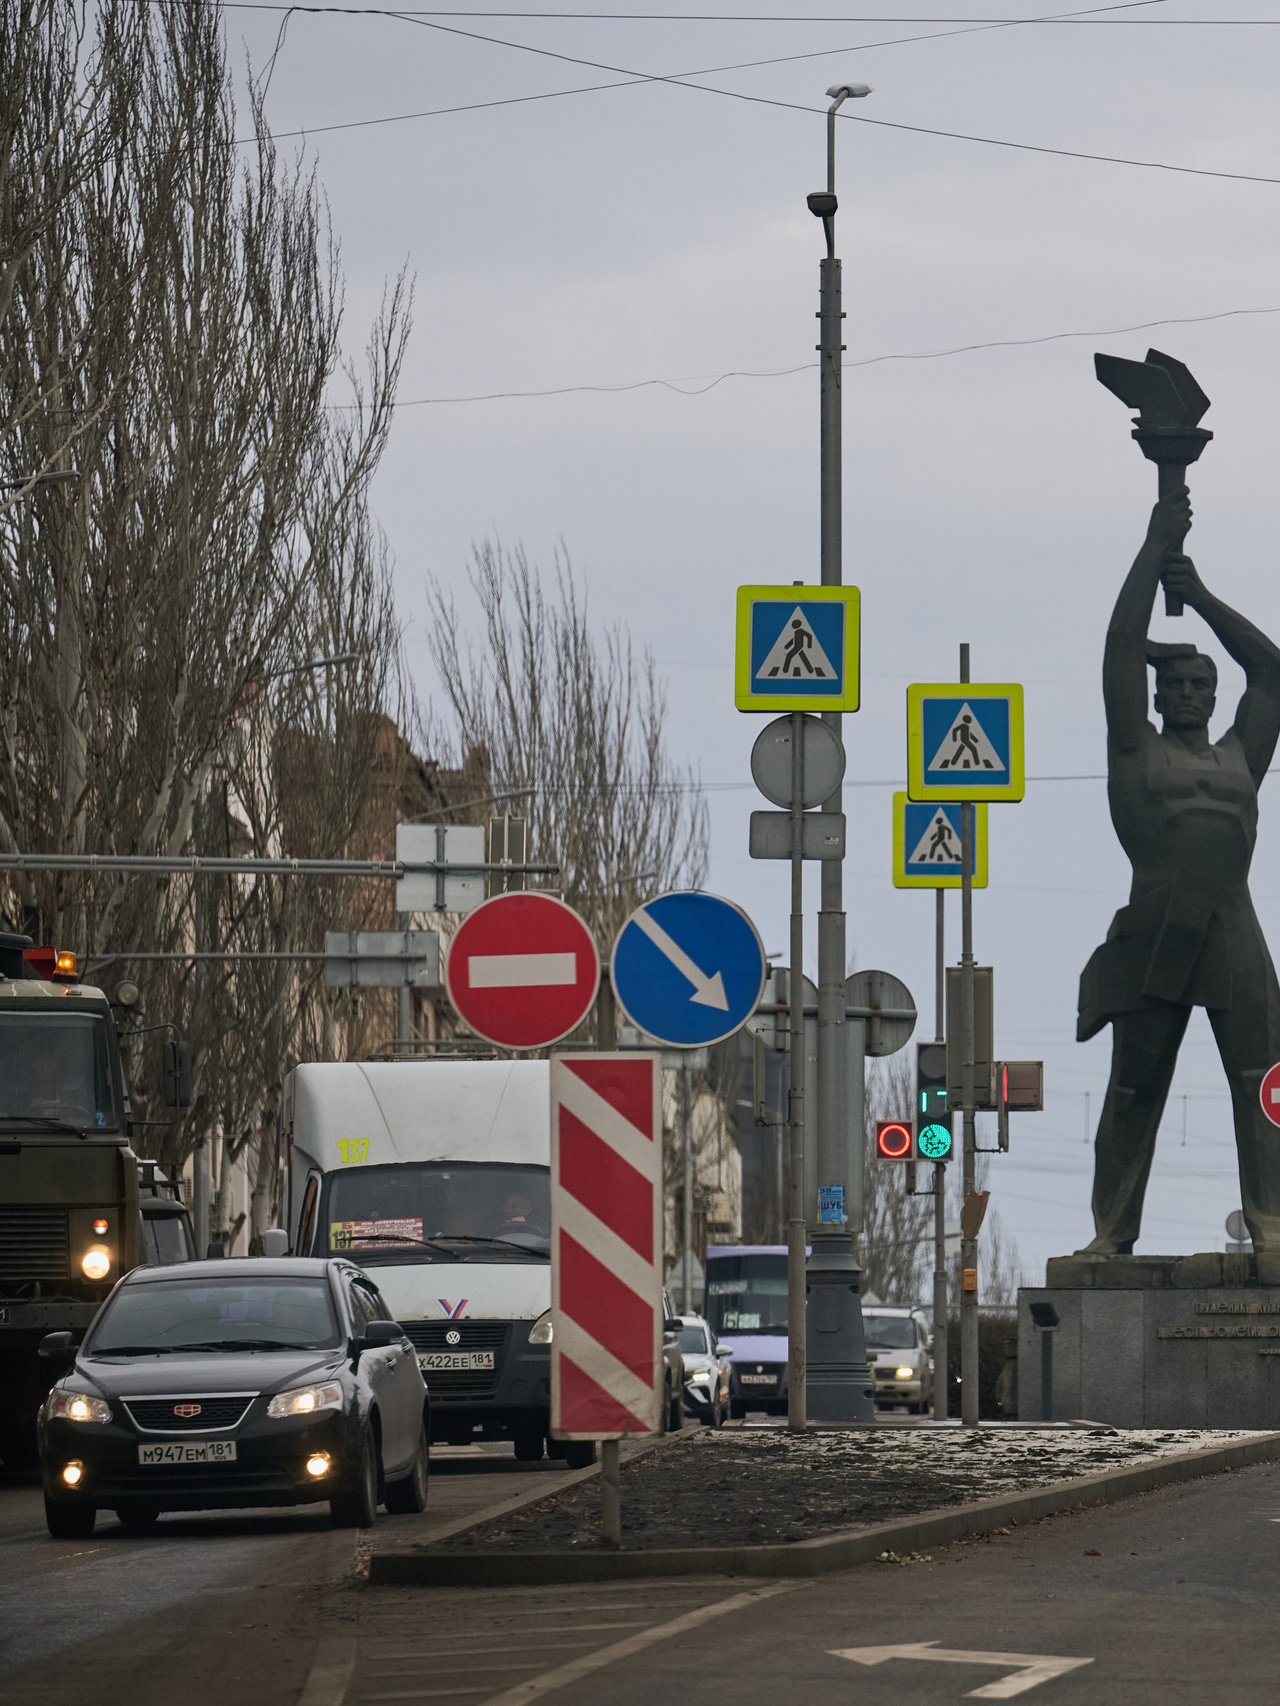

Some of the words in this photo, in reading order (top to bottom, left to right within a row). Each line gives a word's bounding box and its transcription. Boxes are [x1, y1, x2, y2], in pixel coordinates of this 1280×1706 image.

[336, 1138, 370, 1164] 137
[821, 1201, 843, 1210] ШУБ
[333, 1231, 354, 1249] 137
[471, 1353, 490, 1364] 181
[143, 1445, 207, 1463] М947ЕМ
[208, 1442, 232, 1455] 181
